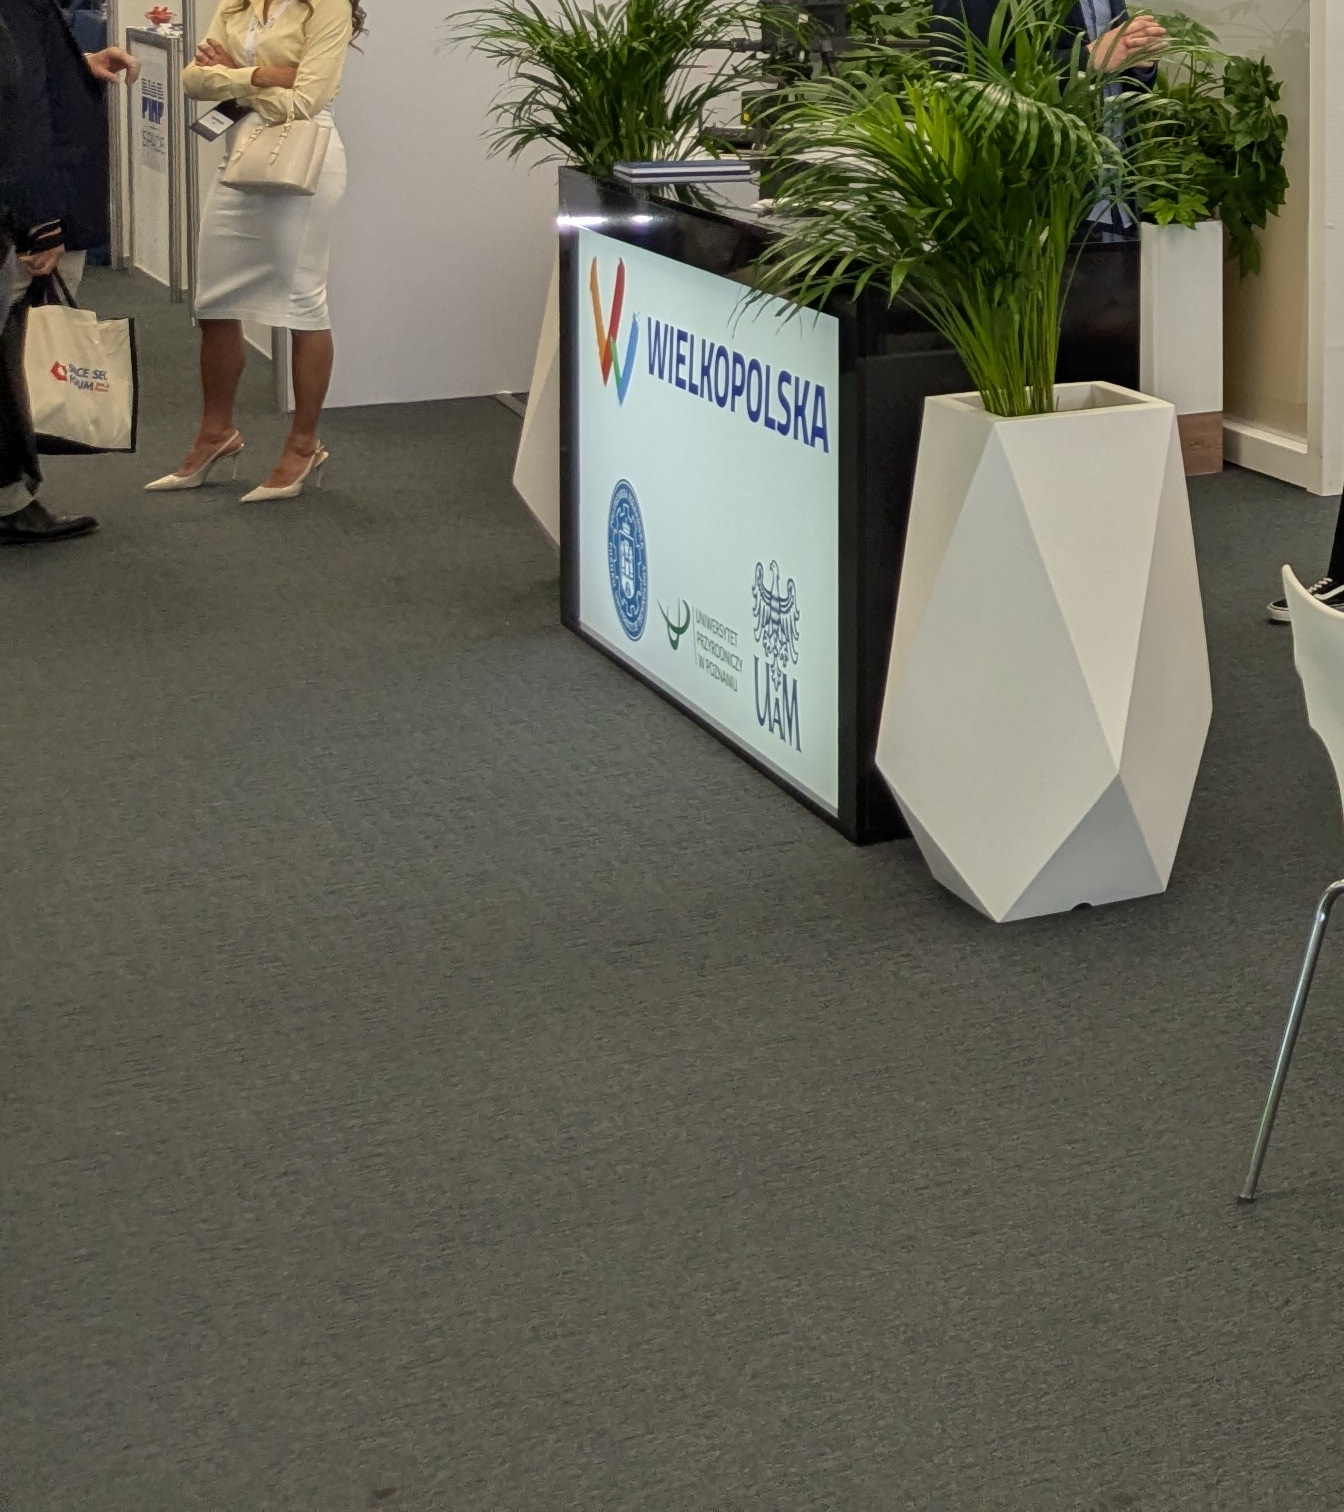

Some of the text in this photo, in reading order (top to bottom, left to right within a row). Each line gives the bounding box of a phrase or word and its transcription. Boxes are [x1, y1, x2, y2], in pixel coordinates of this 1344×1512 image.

[648, 317, 829, 453] WIELKOPOLSKA
[696, 608, 738, 647] UNIWERSYTET
[754, 654, 802, 752] UAM
